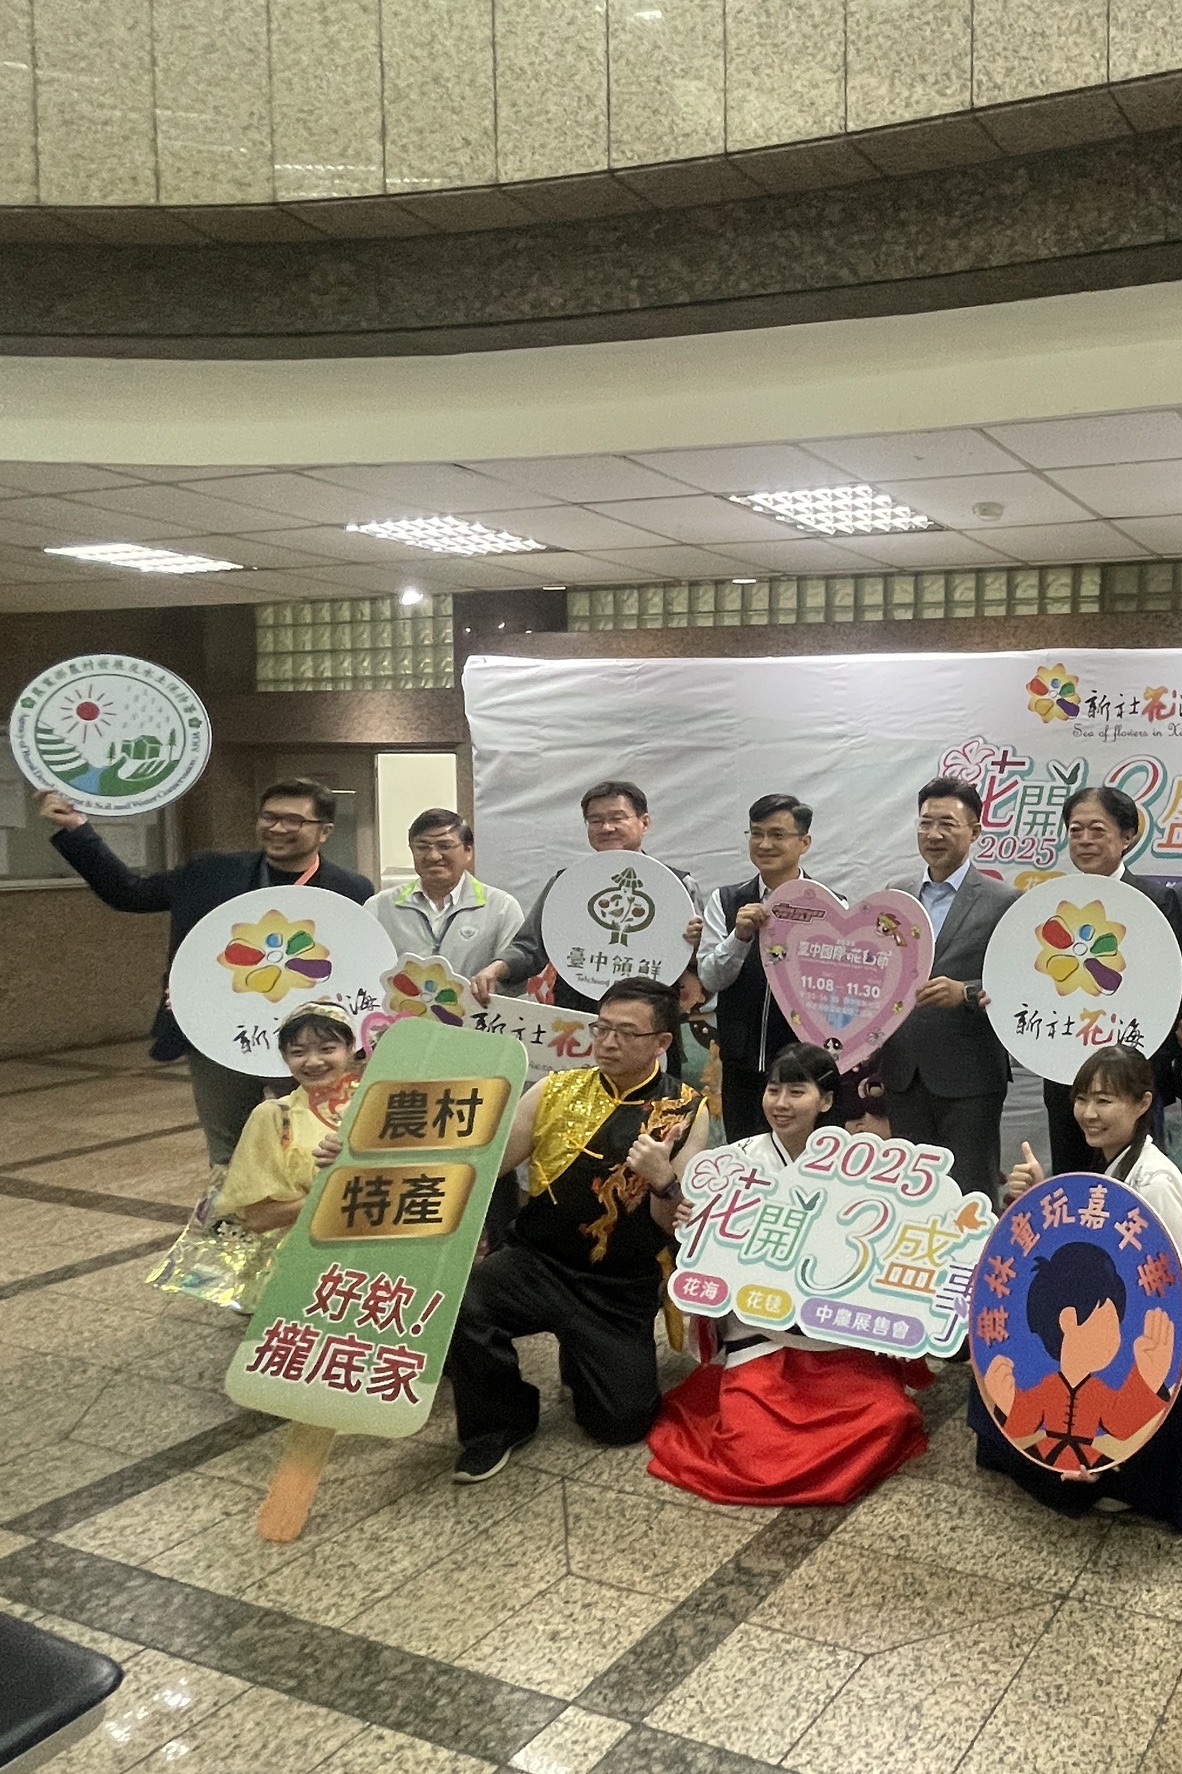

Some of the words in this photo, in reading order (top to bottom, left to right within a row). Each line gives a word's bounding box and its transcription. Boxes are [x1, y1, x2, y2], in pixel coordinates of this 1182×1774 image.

[1072, 723, 1094, 737] Sea
[1098, 725, 1110, 742] of
[1112, 724, 1148, 742] flowers
[1152, 728, 1163, 737] in
[977, 835, 1057, 866] 2025
[800, 976, 835, 992] 11.08
[846, 982, 881, 999] 11.30
[1013, 1003, 1145, 1048] 新社花海
[378, 1087, 484, 1140] 農村
[804, 1135, 941, 1197] 2025
[340, 1173, 446, 1228] 特產
[976, 1183, 1177, 1347] 舞林童玩嘉年華
[683, 1276, 720, 1300] 花海
[746, 1290, 783, 1311] 花毯
[815, 1304, 911, 1339] 中農展售會
[245, 1317, 428, 1405] 攏底家
